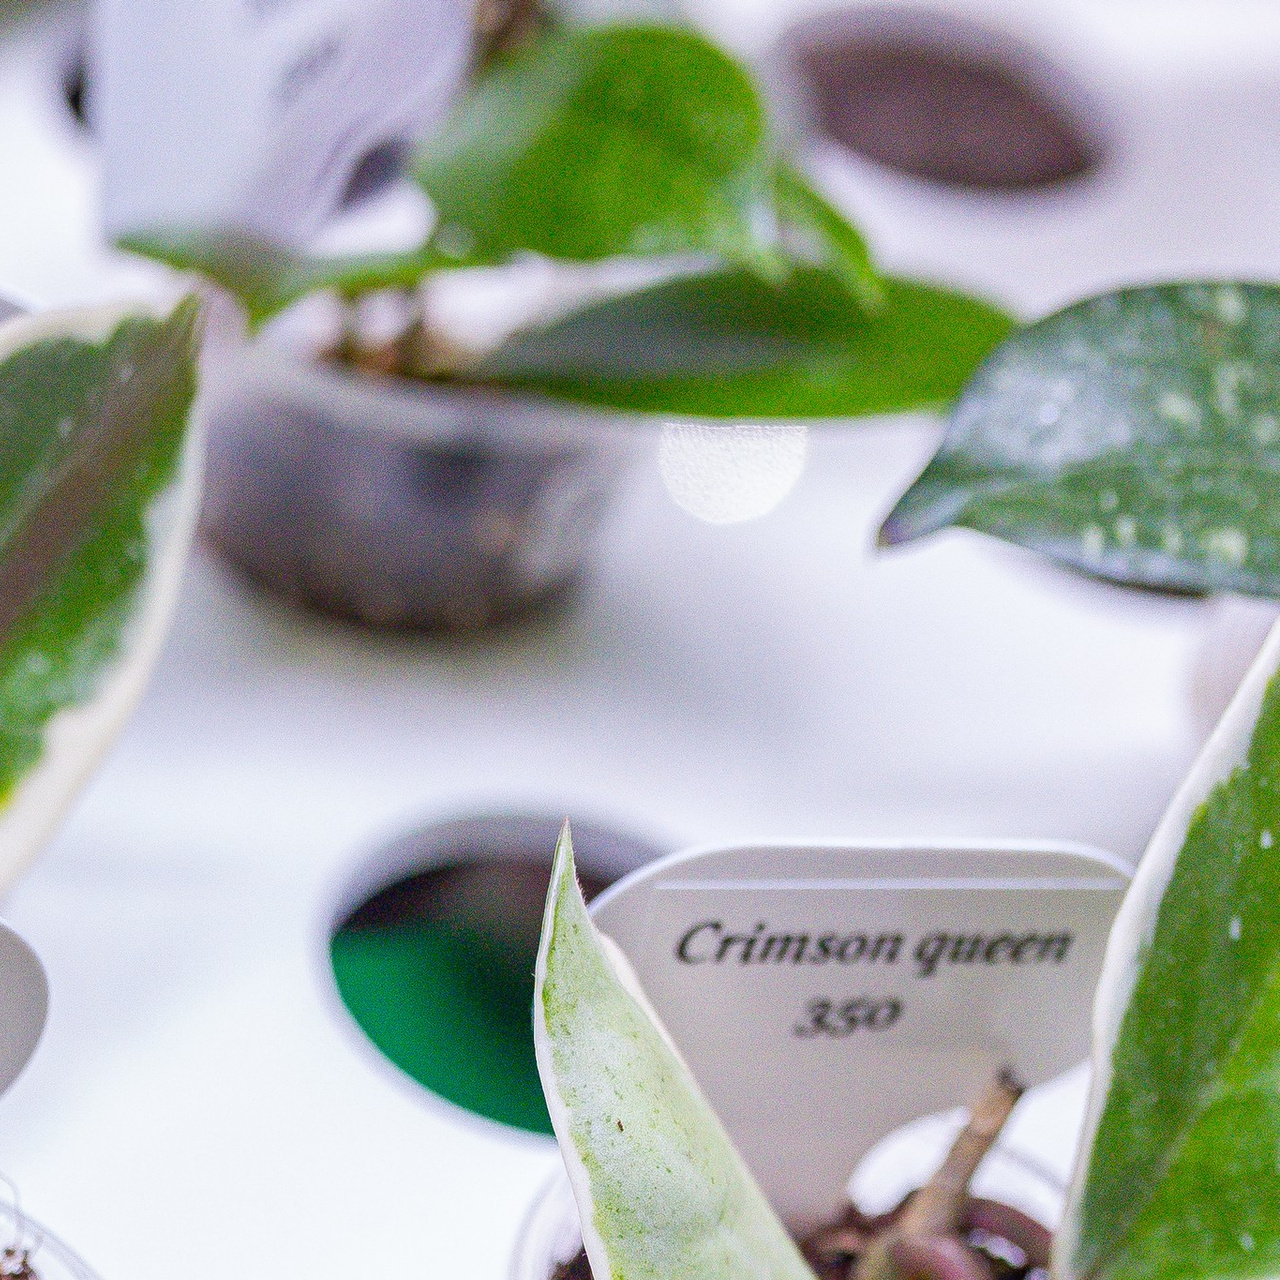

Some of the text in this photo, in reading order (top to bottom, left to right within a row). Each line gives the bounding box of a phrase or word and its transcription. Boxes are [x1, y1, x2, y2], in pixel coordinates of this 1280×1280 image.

[674, 921, 1073, 977] Crimson queen
[795, 998, 902, 1038] 350
